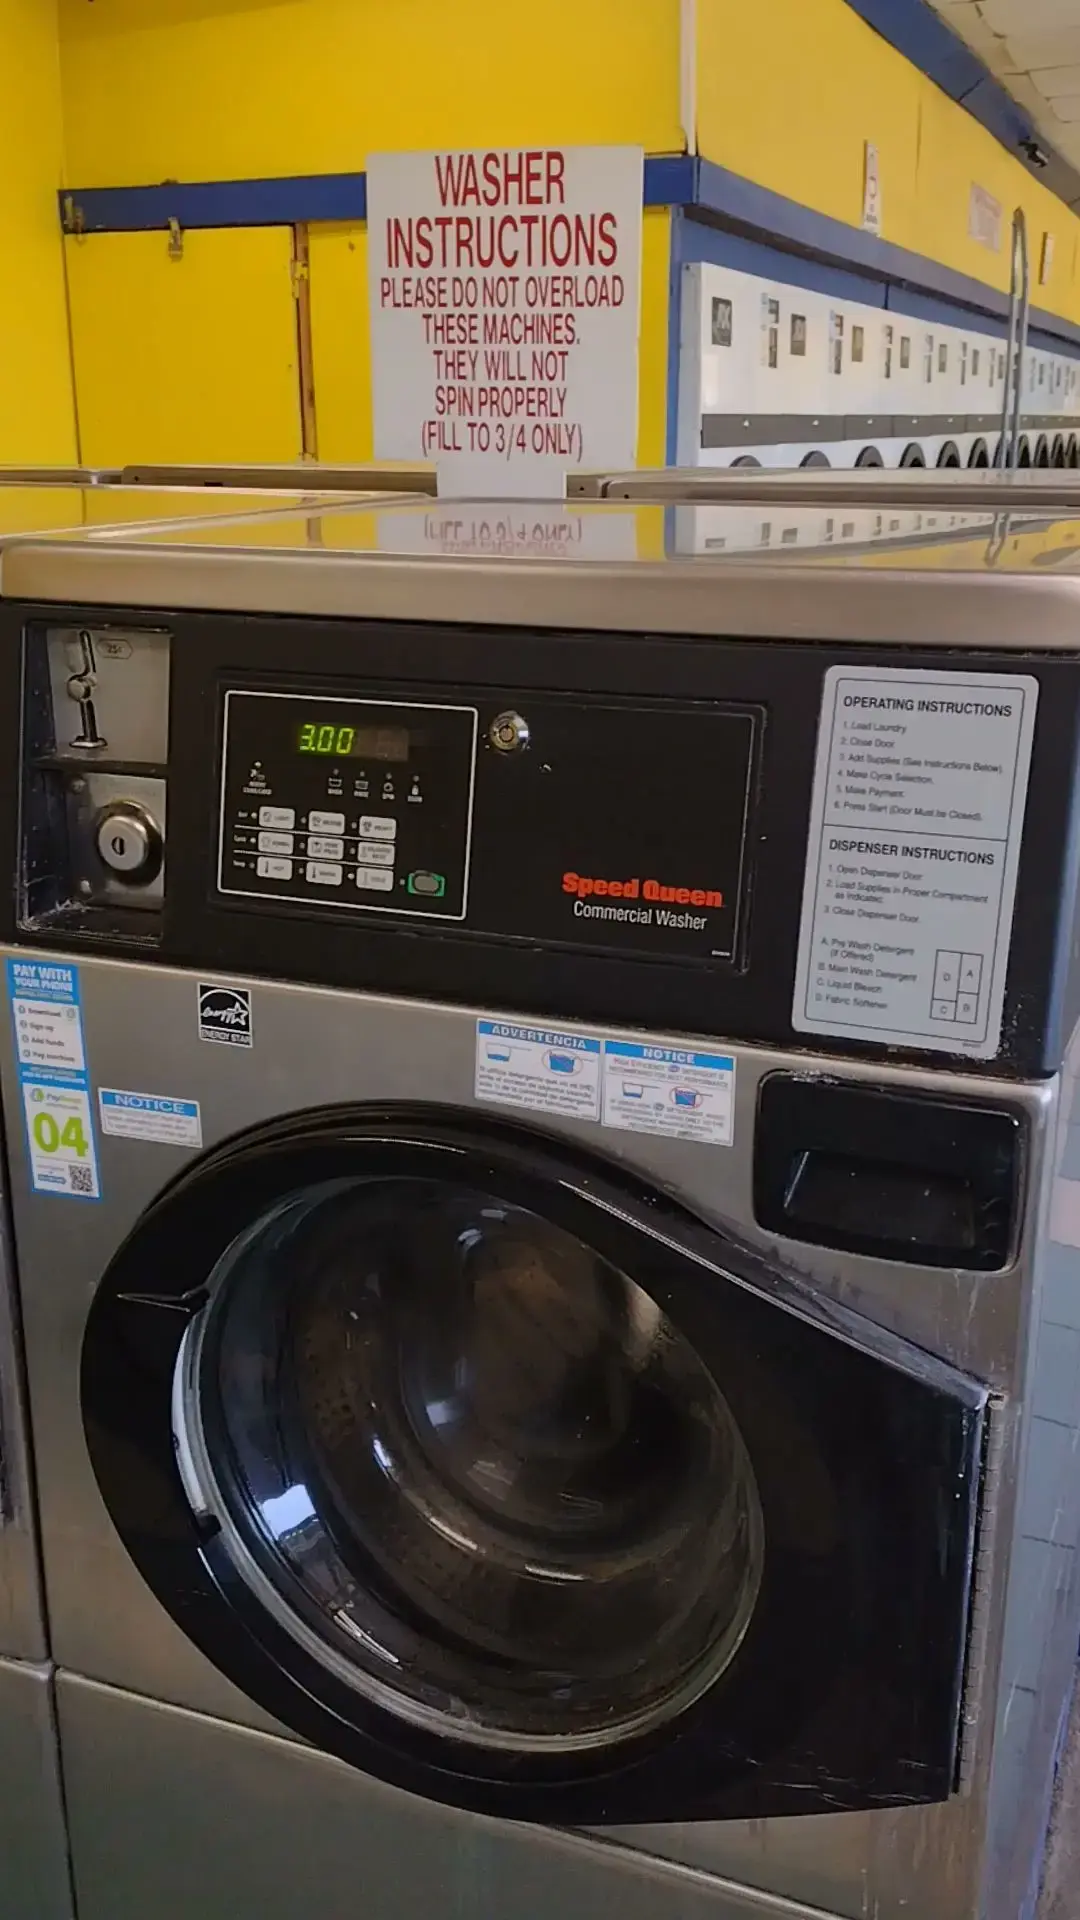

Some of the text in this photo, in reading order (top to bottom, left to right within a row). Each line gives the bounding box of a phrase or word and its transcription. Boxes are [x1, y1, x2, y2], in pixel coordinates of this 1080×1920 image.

[435, 151, 565, 207] WASHER
[387, 212, 618, 268] INSTRUCTIONS
[381, 275, 624, 308] PLEASE DO NOT OVERLOAD
[422, 313, 581, 345] THESE MACHINES.
[433, 350, 569, 381] THEY WILL NOT
[435, 385, 567, 418] SPIN PROPERLY
[421, 421, 583, 462] (FILL TO 3/4 ONLY)
[843, 695, 1012, 717] OPERATING INSTRUCTIONS
[299, 724, 355, 755] 3.00
[829, 839, 995, 865] DISPENSER INSTRUCTIONS
[562, 871, 723, 907] Speed Queen
[573, 900, 707, 930] Commercial Washer
[13, 963, 72, 982] PAY WITH
[14, 976, 73, 992] YOUR PHONE
[966, 969, 974, 979] A
[200, 1029, 250, 1043] ENERGY STAR
[492, 1025, 587, 1049] ADVERTENCIA
[643, 1047, 696, 1064] NOTICE
[114, 1094, 185, 1114] NOTICE
[33, 1112, 89, 1157] 04
